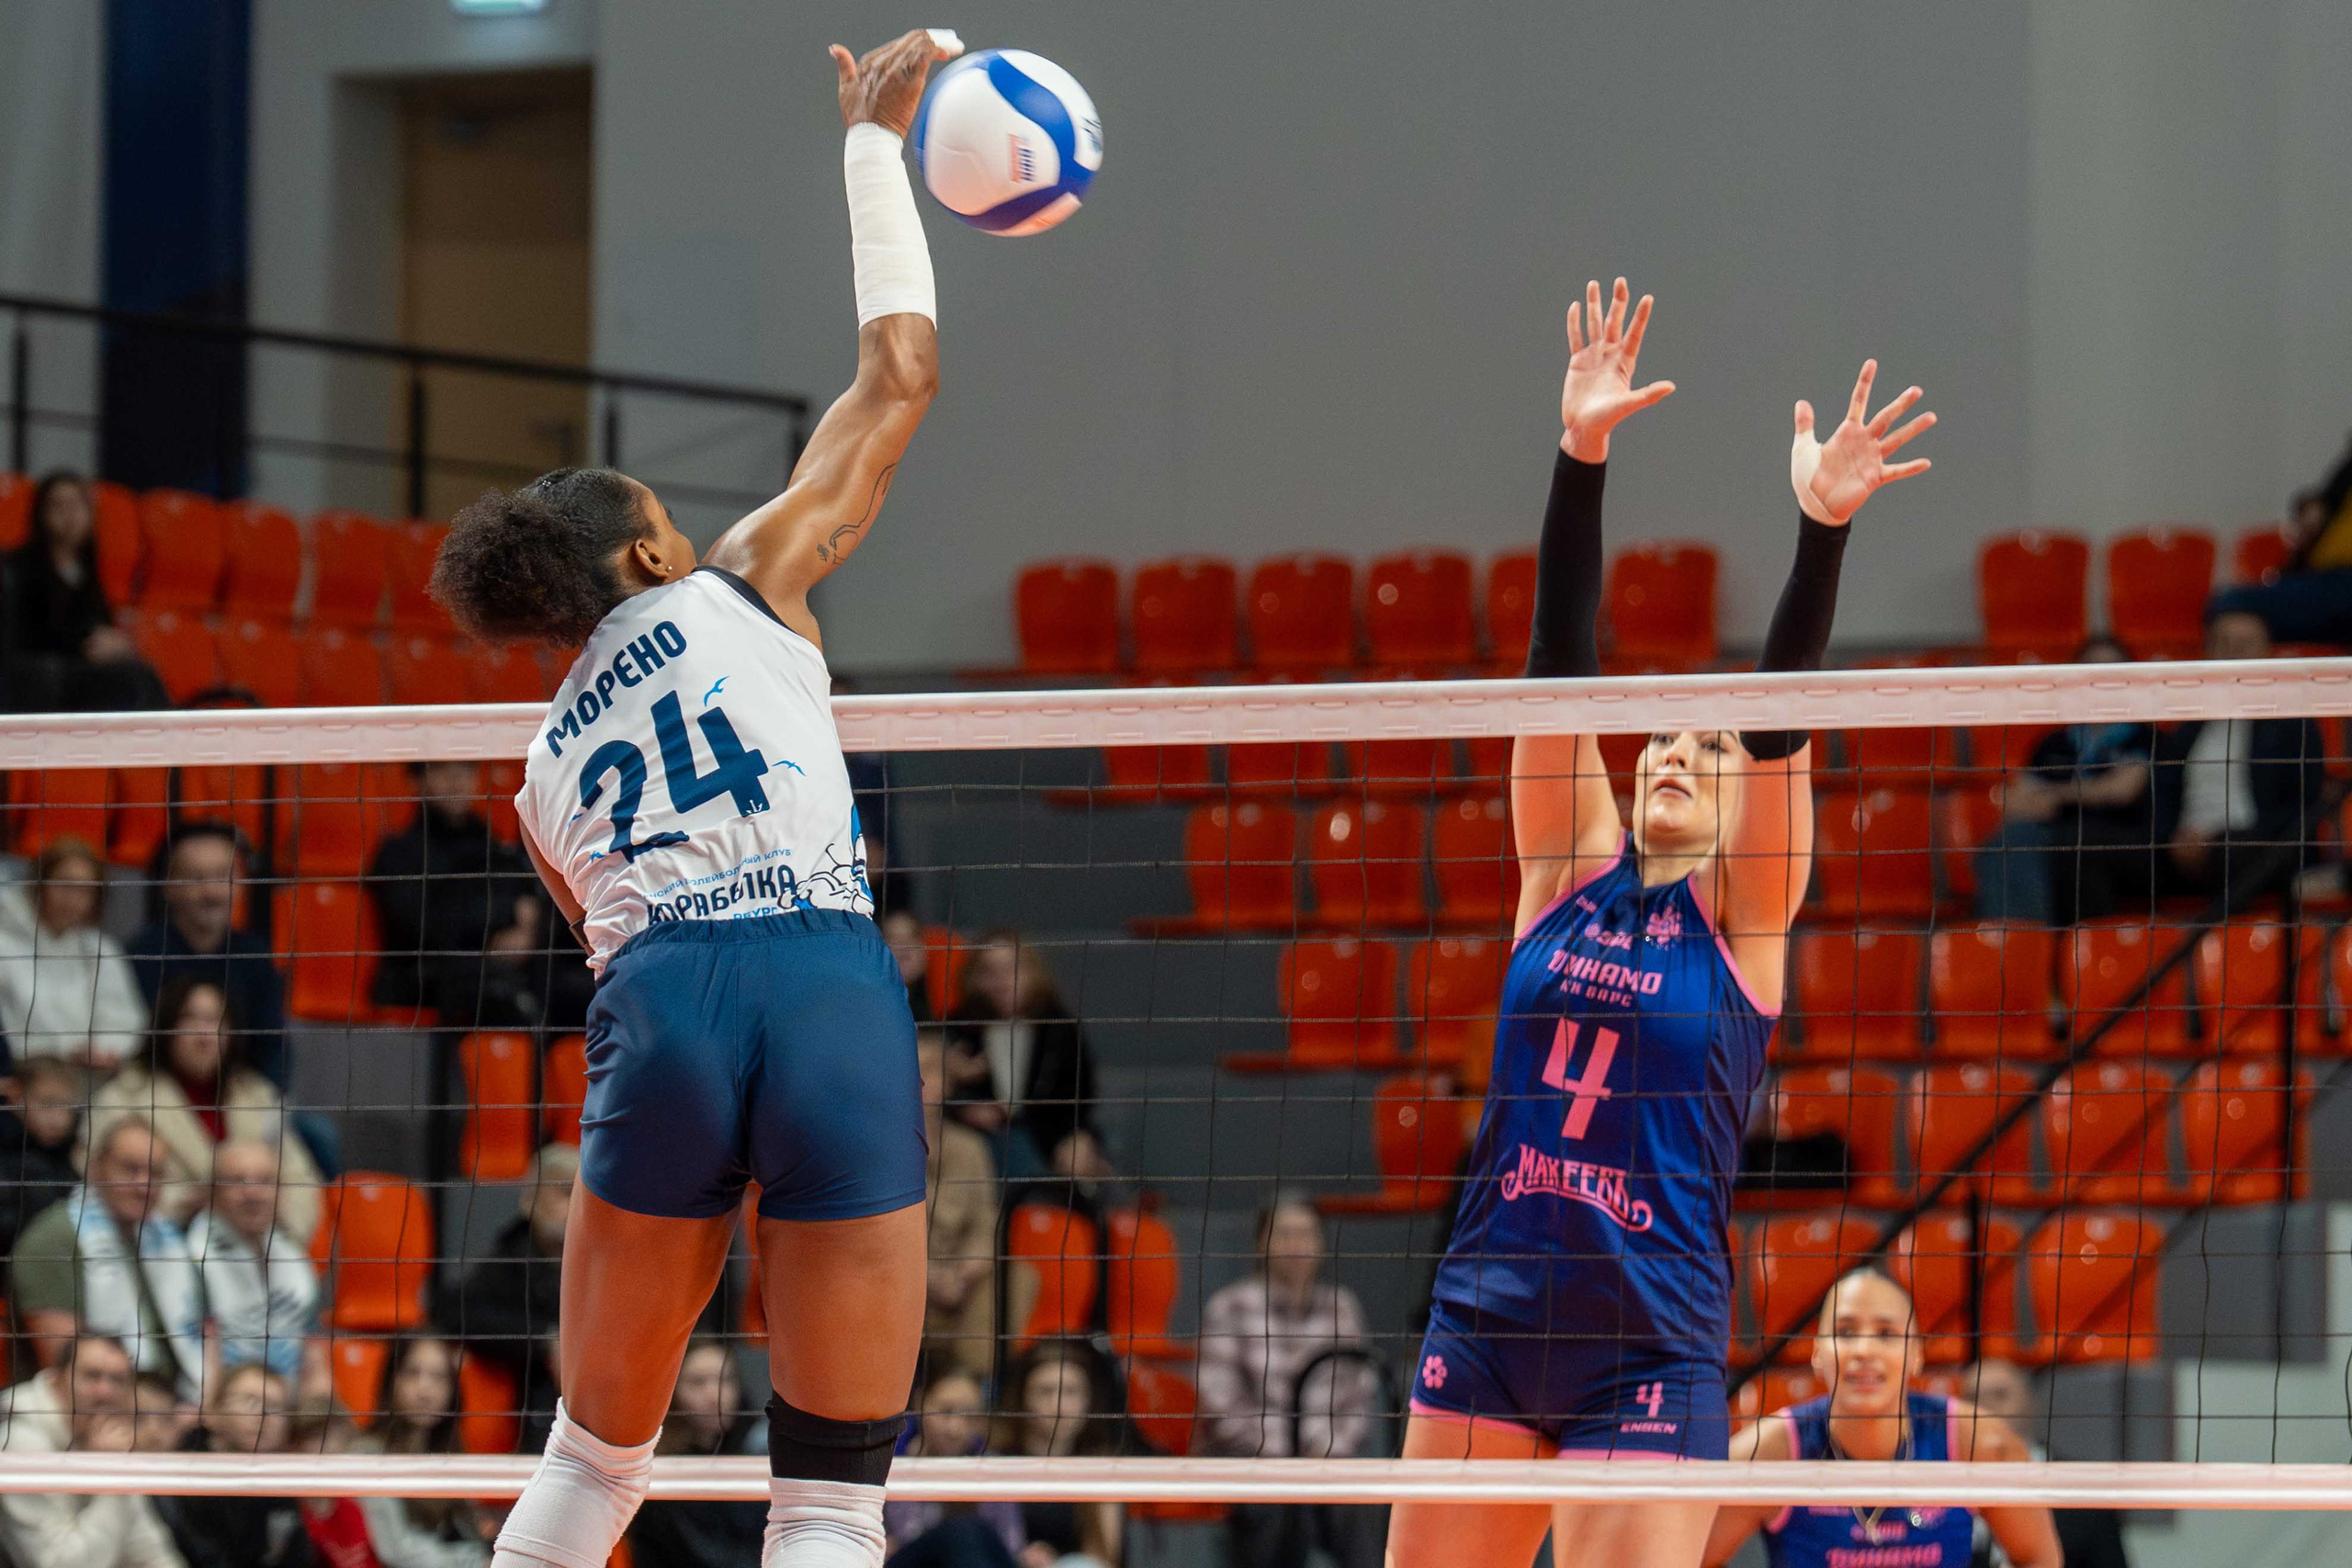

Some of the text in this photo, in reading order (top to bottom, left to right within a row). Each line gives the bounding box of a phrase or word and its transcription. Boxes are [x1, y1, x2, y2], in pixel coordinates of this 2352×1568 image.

[546, 620, 687, 758] МОРЕНО
[579, 690, 770, 863] 24
[764, 849, 791, 861] КЛУБ
[1547, 949, 1663, 995] ДИНАМО
[1541, 1017, 1620, 1141] 4
[1636, 1381, 1664, 1418] 4
